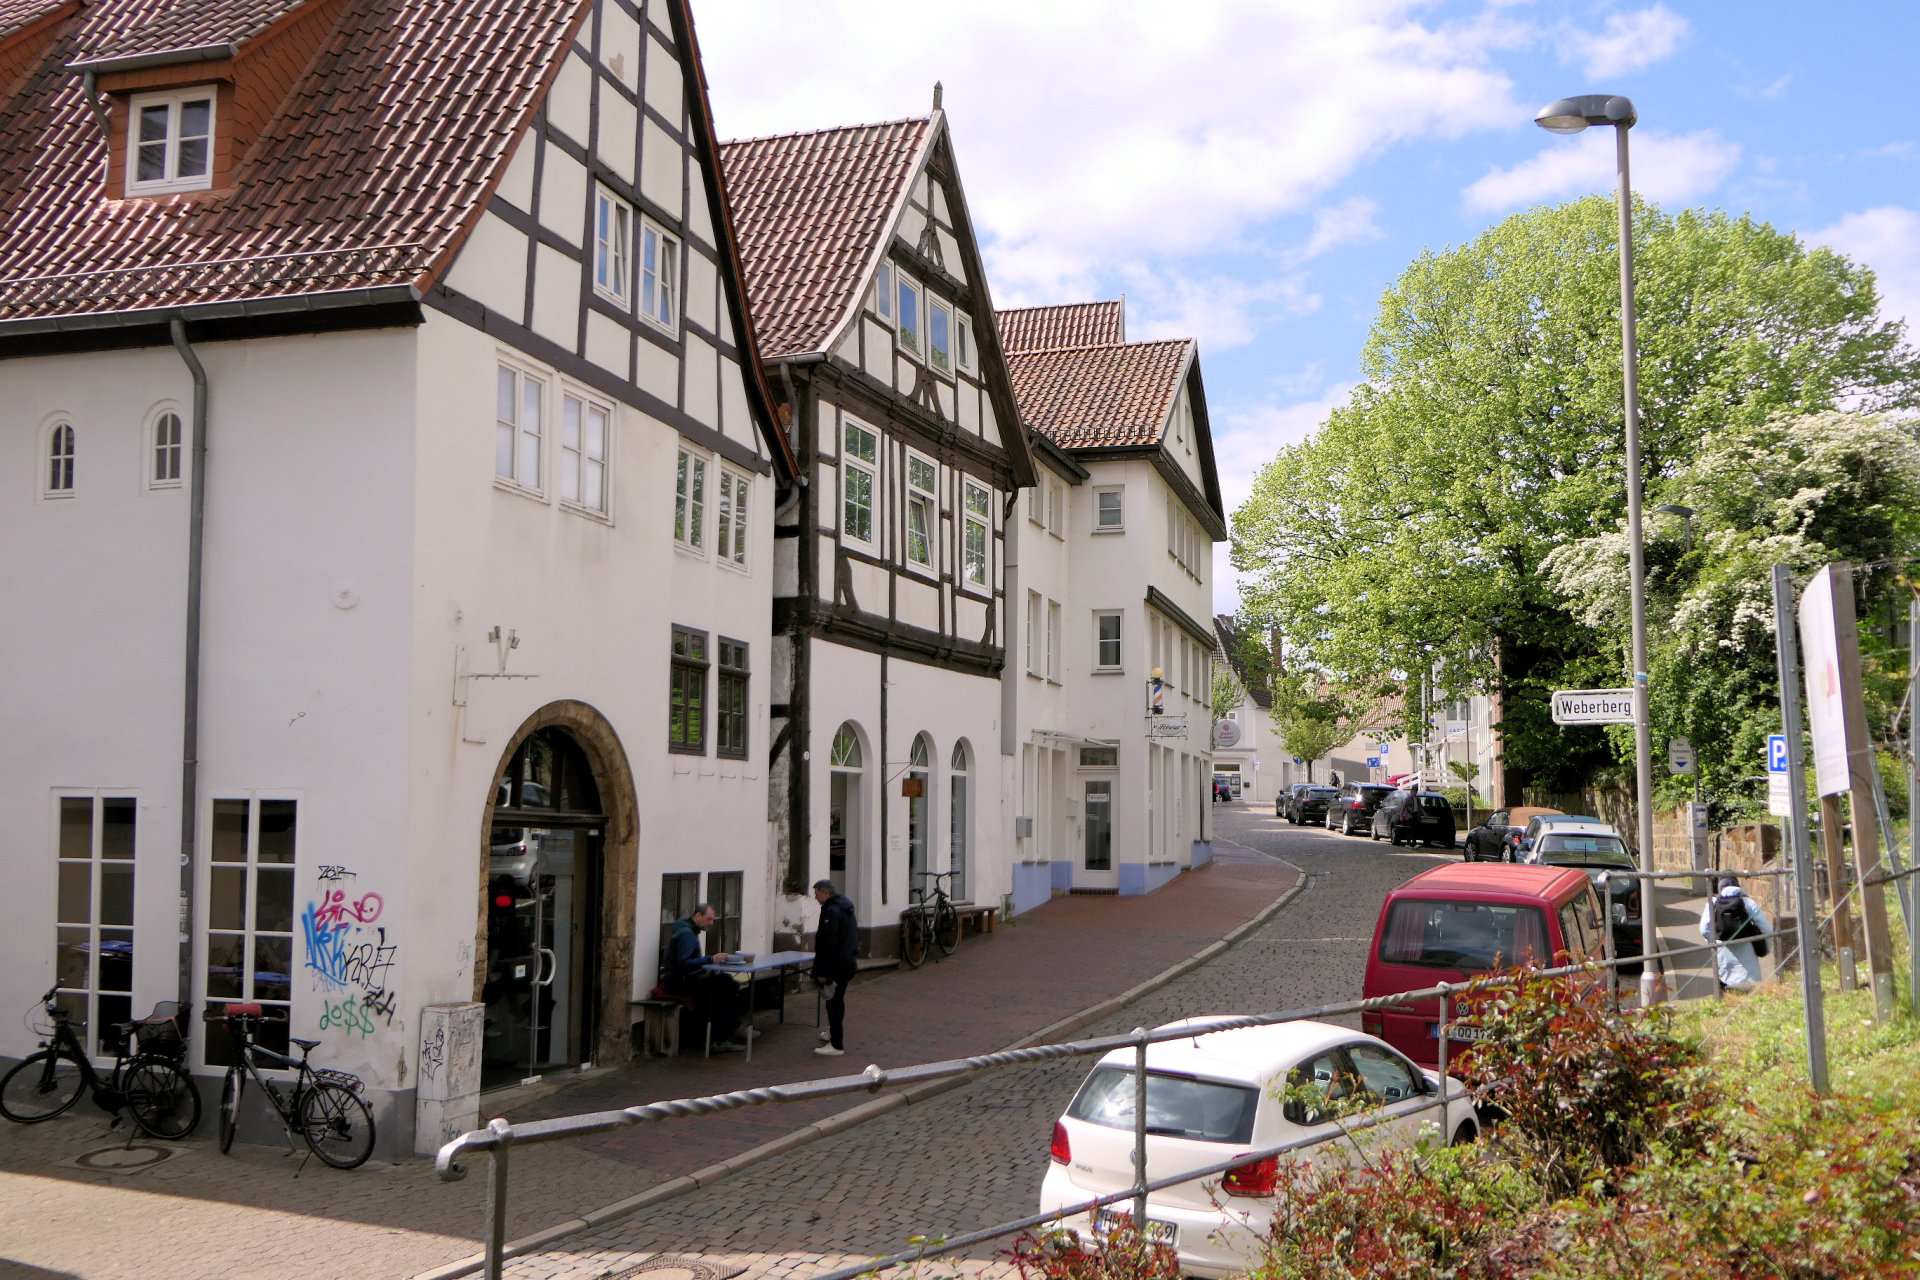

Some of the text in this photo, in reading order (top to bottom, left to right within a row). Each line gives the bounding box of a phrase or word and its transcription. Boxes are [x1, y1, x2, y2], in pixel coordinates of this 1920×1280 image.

[1561, 699, 1631, 716] Weberberg
[1772, 739, 1786, 769] P
[1457, 1027, 1472, 1039] QQ
